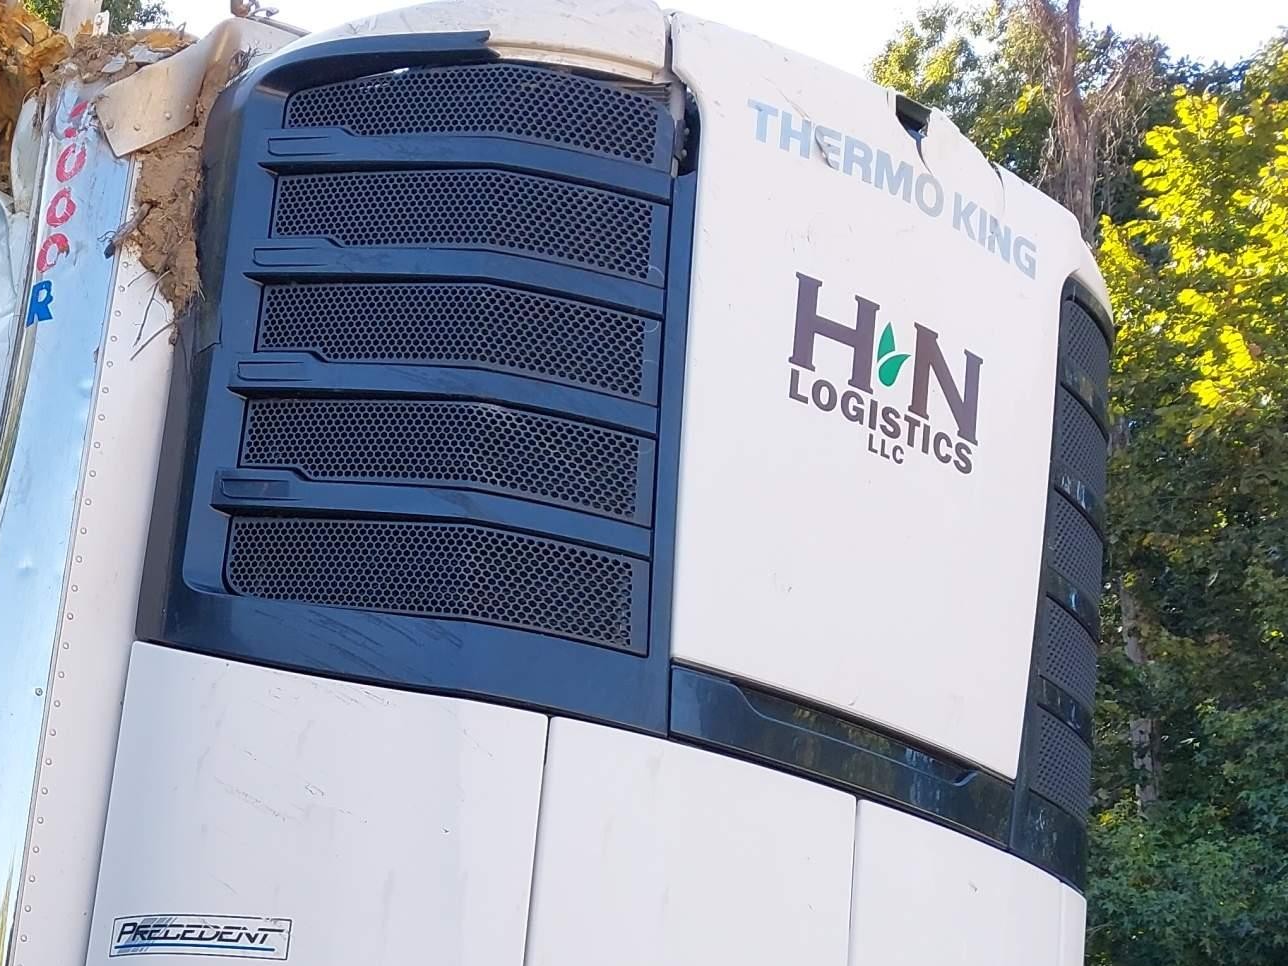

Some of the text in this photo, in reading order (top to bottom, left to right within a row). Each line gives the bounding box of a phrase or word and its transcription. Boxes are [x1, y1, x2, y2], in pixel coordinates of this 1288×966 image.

[747, 98, 1037, 280] THERMO KING
[788, 367, 973, 475] LOGISTICS
[867, 433, 905, 464] LLC
[117, 922, 285, 945] PRECEDENT
